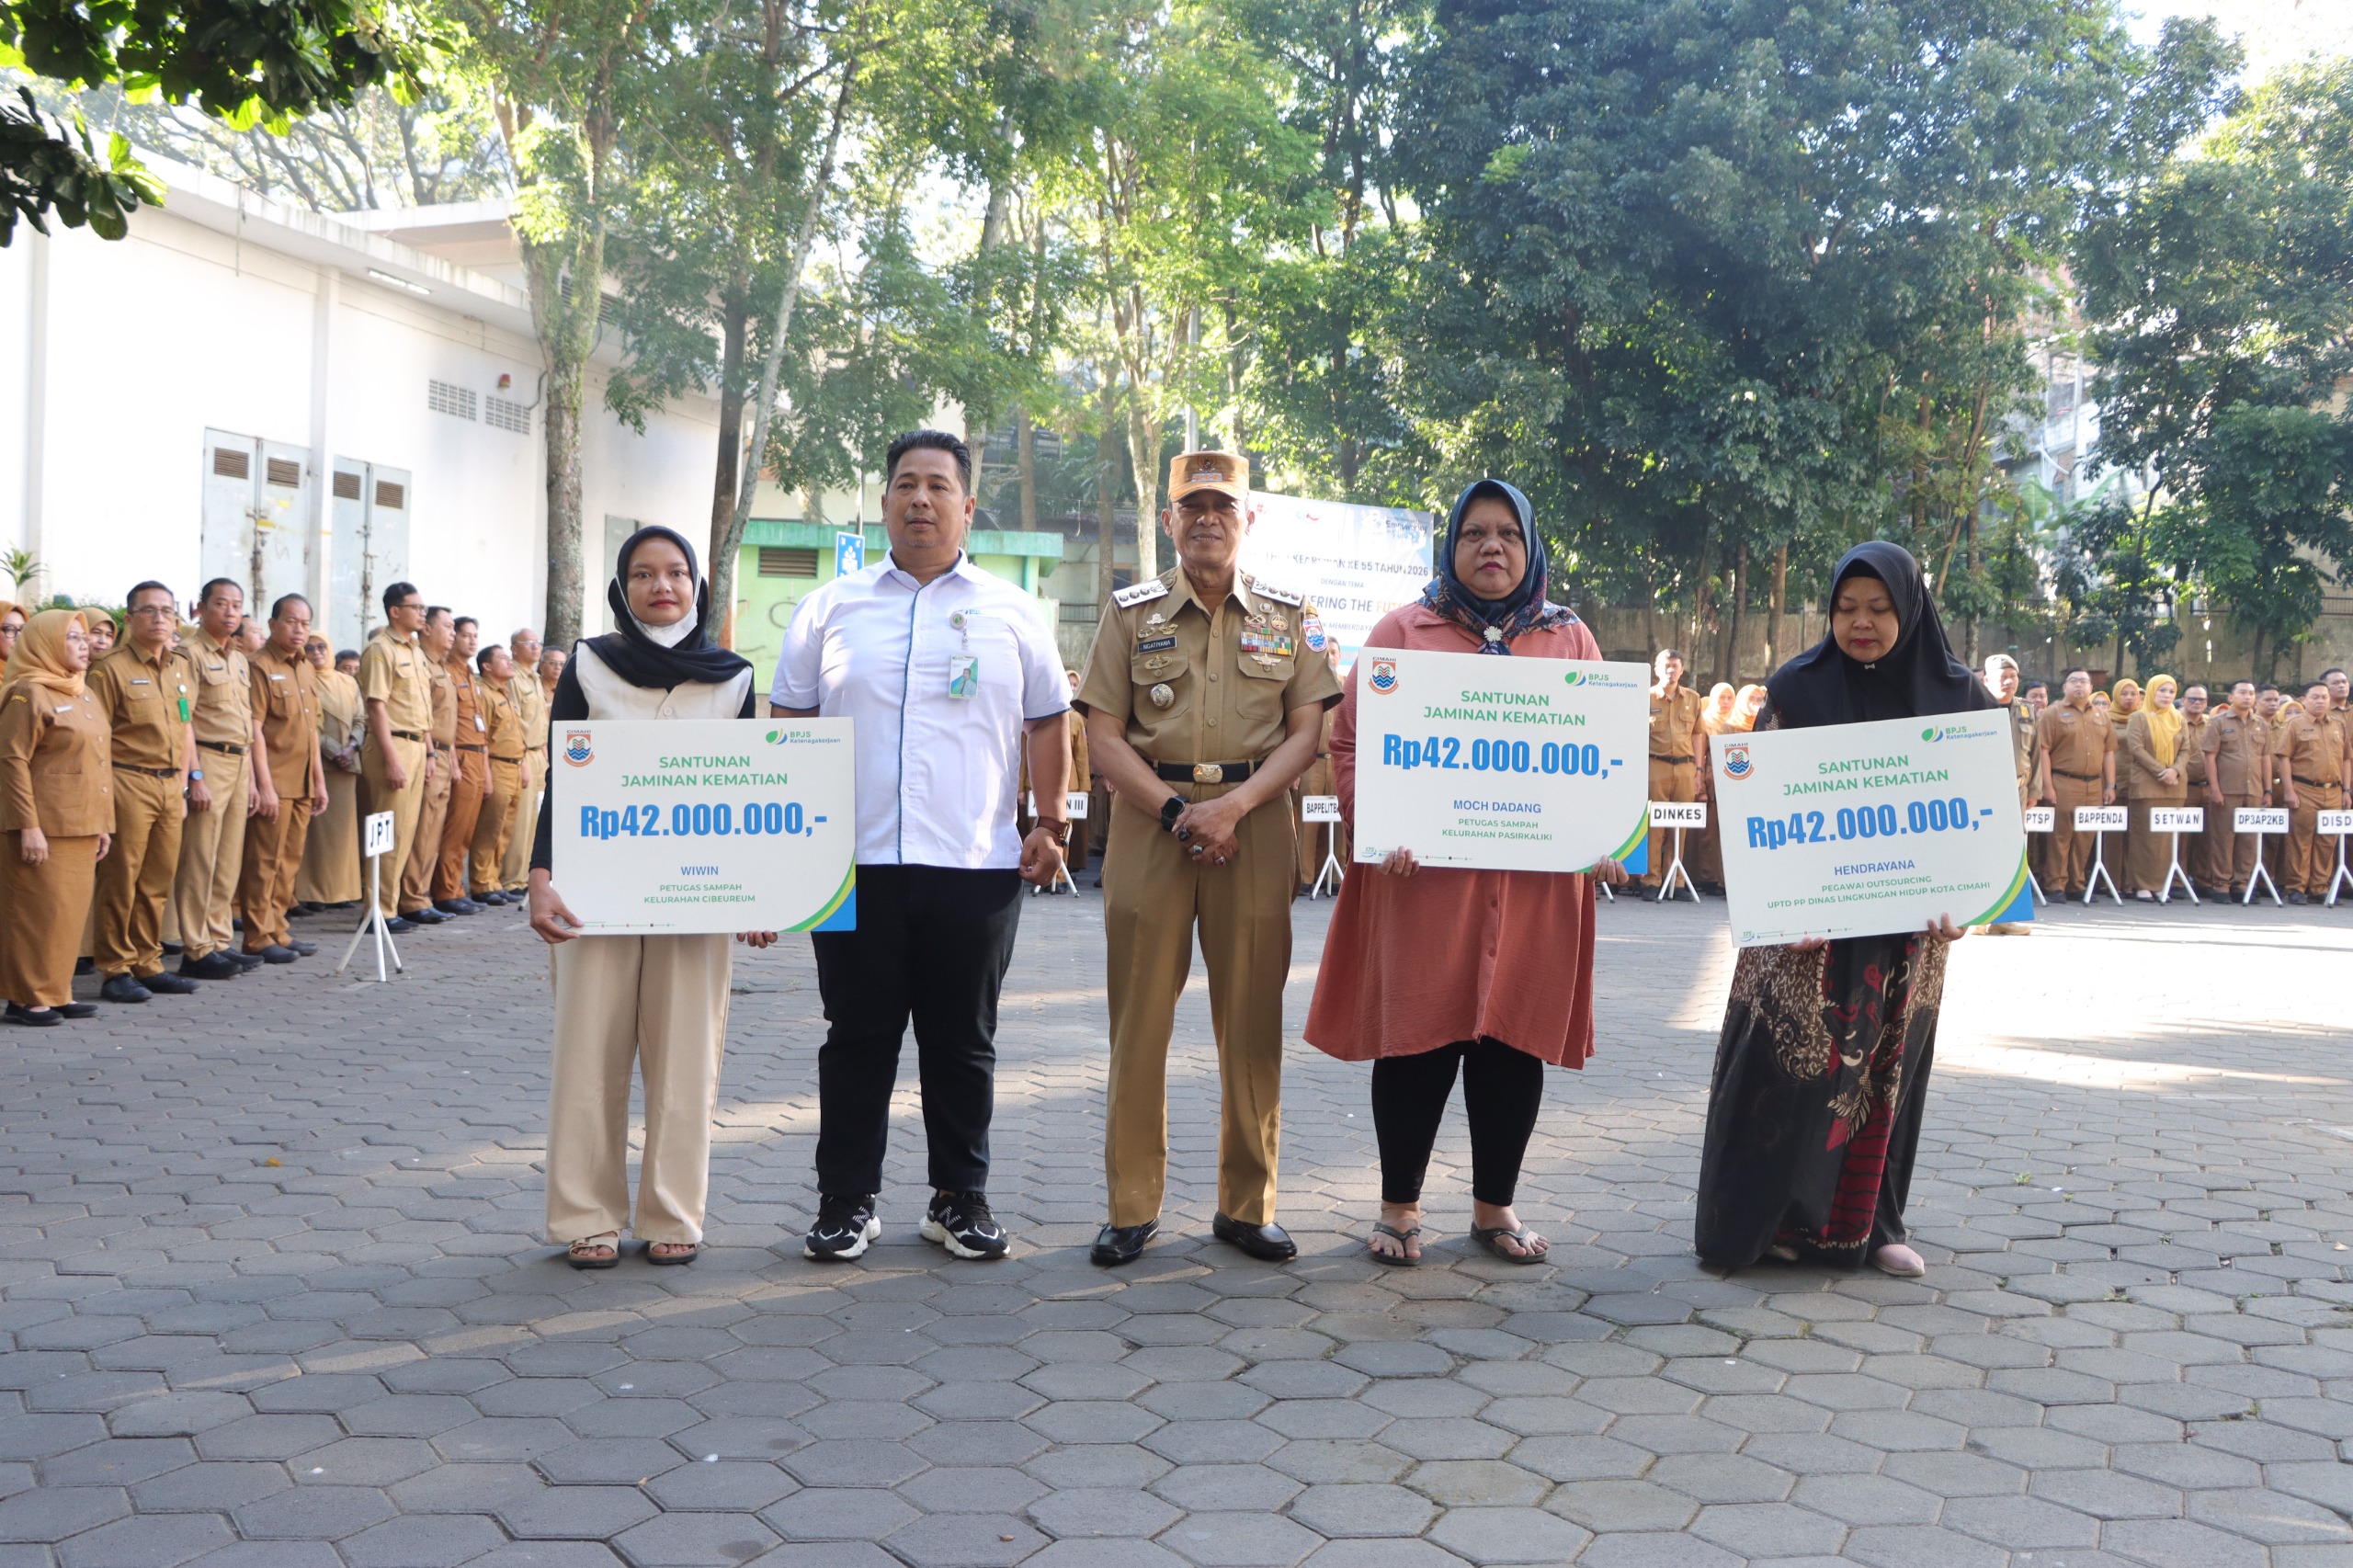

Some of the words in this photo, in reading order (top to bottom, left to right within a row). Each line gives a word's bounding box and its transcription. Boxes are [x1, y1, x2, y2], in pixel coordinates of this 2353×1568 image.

[1361, 562, 1372, 571] 55
[1375, 562, 1406, 574] TAHUN
[1407, 565, 1428, 576] 2026
[1321, 578, 1347, 588] DENGAN
[1349, 580, 1364, 588] TEMA
[1351, 599, 1373, 612] THE
[1461, 690, 1549, 706] SANTUNAN
[1423, 707, 1497, 722] JAMINAN
[1503, 711, 1585, 726] KEMATIAN
[1946, 730, 1997, 741] Ketenagakerjaan
[659, 756, 750, 767] SANTUNAN
[1383, 733, 1622, 779] Rp42.000.000,-
[1818, 756, 1909, 775] SANTUNAN
[621, 775, 698, 787] JAMINAN
[703, 773, 788, 786] KEMATIAN
[1783, 778, 1859, 796] JAMINAN
[1863, 769, 1949, 789] KEMATIAN
[1307, 802, 1339, 814] BAPPELITB
[1453, 801, 1489, 811] MOCH
[1492, 801, 1541, 813] DADANG
[1654, 808, 1701, 820] DINKES
[2026, 813, 2050, 824] PTSP
[2079, 812, 2123, 824] BAPPENDA
[2154, 814, 2200, 824] SETWAN
[2239, 814, 2285, 825] DP3AP2KB
[581, 802, 827, 840] Rp42.000.000,-
[1459, 818, 1498, 827] PETUGAS
[1747, 797, 1993, 850] Rp42.000.000,-
[370, 820, 390, 847] JPT
[1442, 829, 1495, 838] KELURAHAN
[1498, 832, 1552, 840] PASIRKALIKI
[681, 866, 719, 875] WIWIN
[1835, 859, 1915, 875] HENDRAYANA
[1822, 881, 1864, 892] PEGAWAI
[1867, 875, 1931, 890] OUTSOURCING
[1768, 901, 1791, 909] UPTD
[1808, 895, 1836, 905] DINAS
[1838, 891, 1896, 903] LINGKUNGAN
[1899, 888, 1927, 897] HIDUP
[1930, 885, 1955, 894] KOTA
[1958, 882, 1990, 892] CIMAHI
